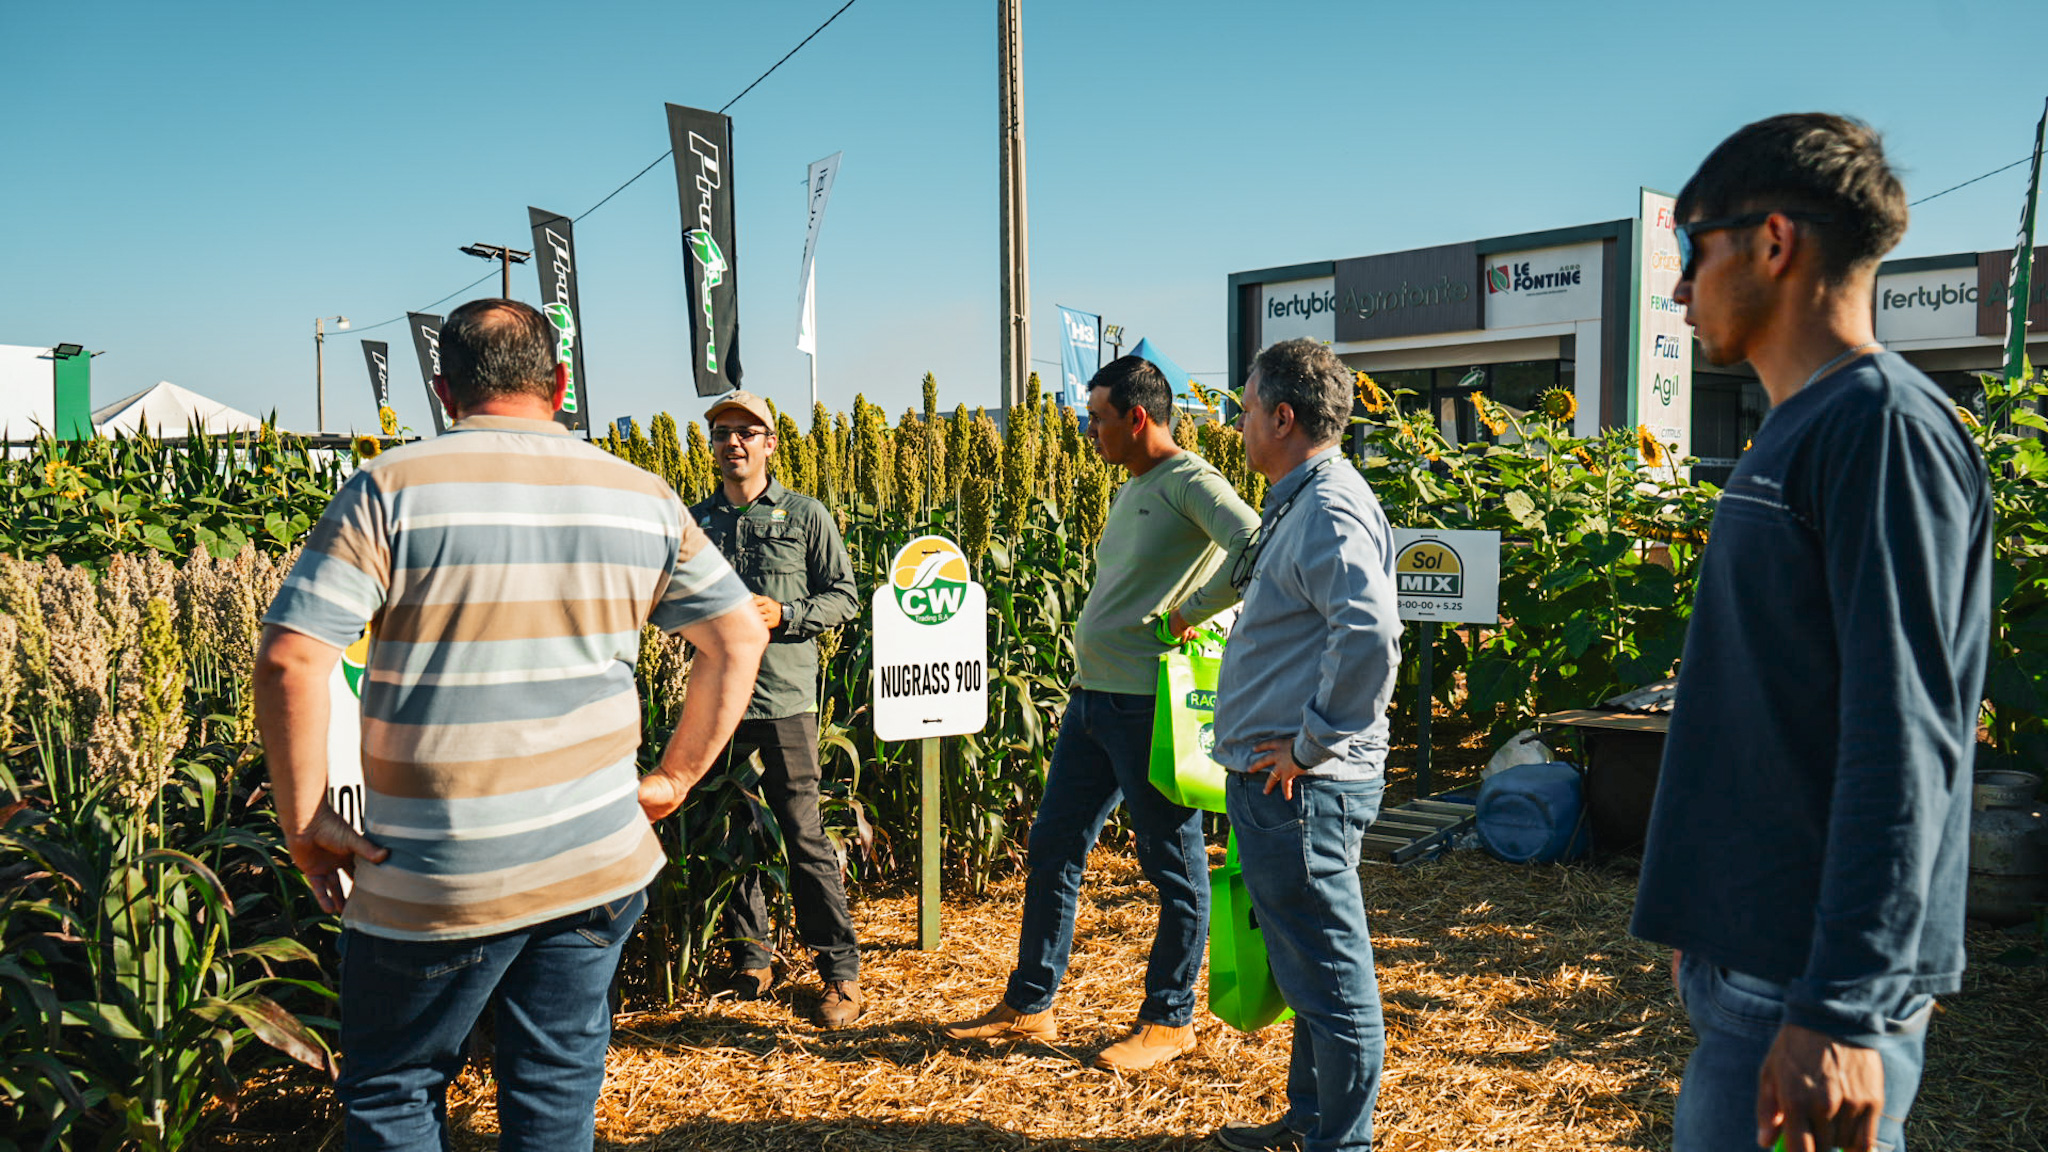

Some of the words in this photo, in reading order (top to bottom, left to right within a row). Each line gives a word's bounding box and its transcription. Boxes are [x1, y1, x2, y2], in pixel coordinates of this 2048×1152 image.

[1514, 262, 1530, 277] LE
[1652, 252, 1681, 271] Orang
[1514, 270, 1581, 291] FONTINE
[1071, 322, 1096, 343] H3
[1653, 335, 1680, 358] Full
[1652, 372, 1679, 406] Agil
[1412, 551, 1443, 569] Sol
[1401, 575, 1453, 592] MIX
[901, 587, 962, 616] CW
[915, 614, 938, 623] Trading
[881, 662, 950, 699] NUGRASS
[955, 660, 981, 692] 900
[1191, 693, 1217, 708] RAG
